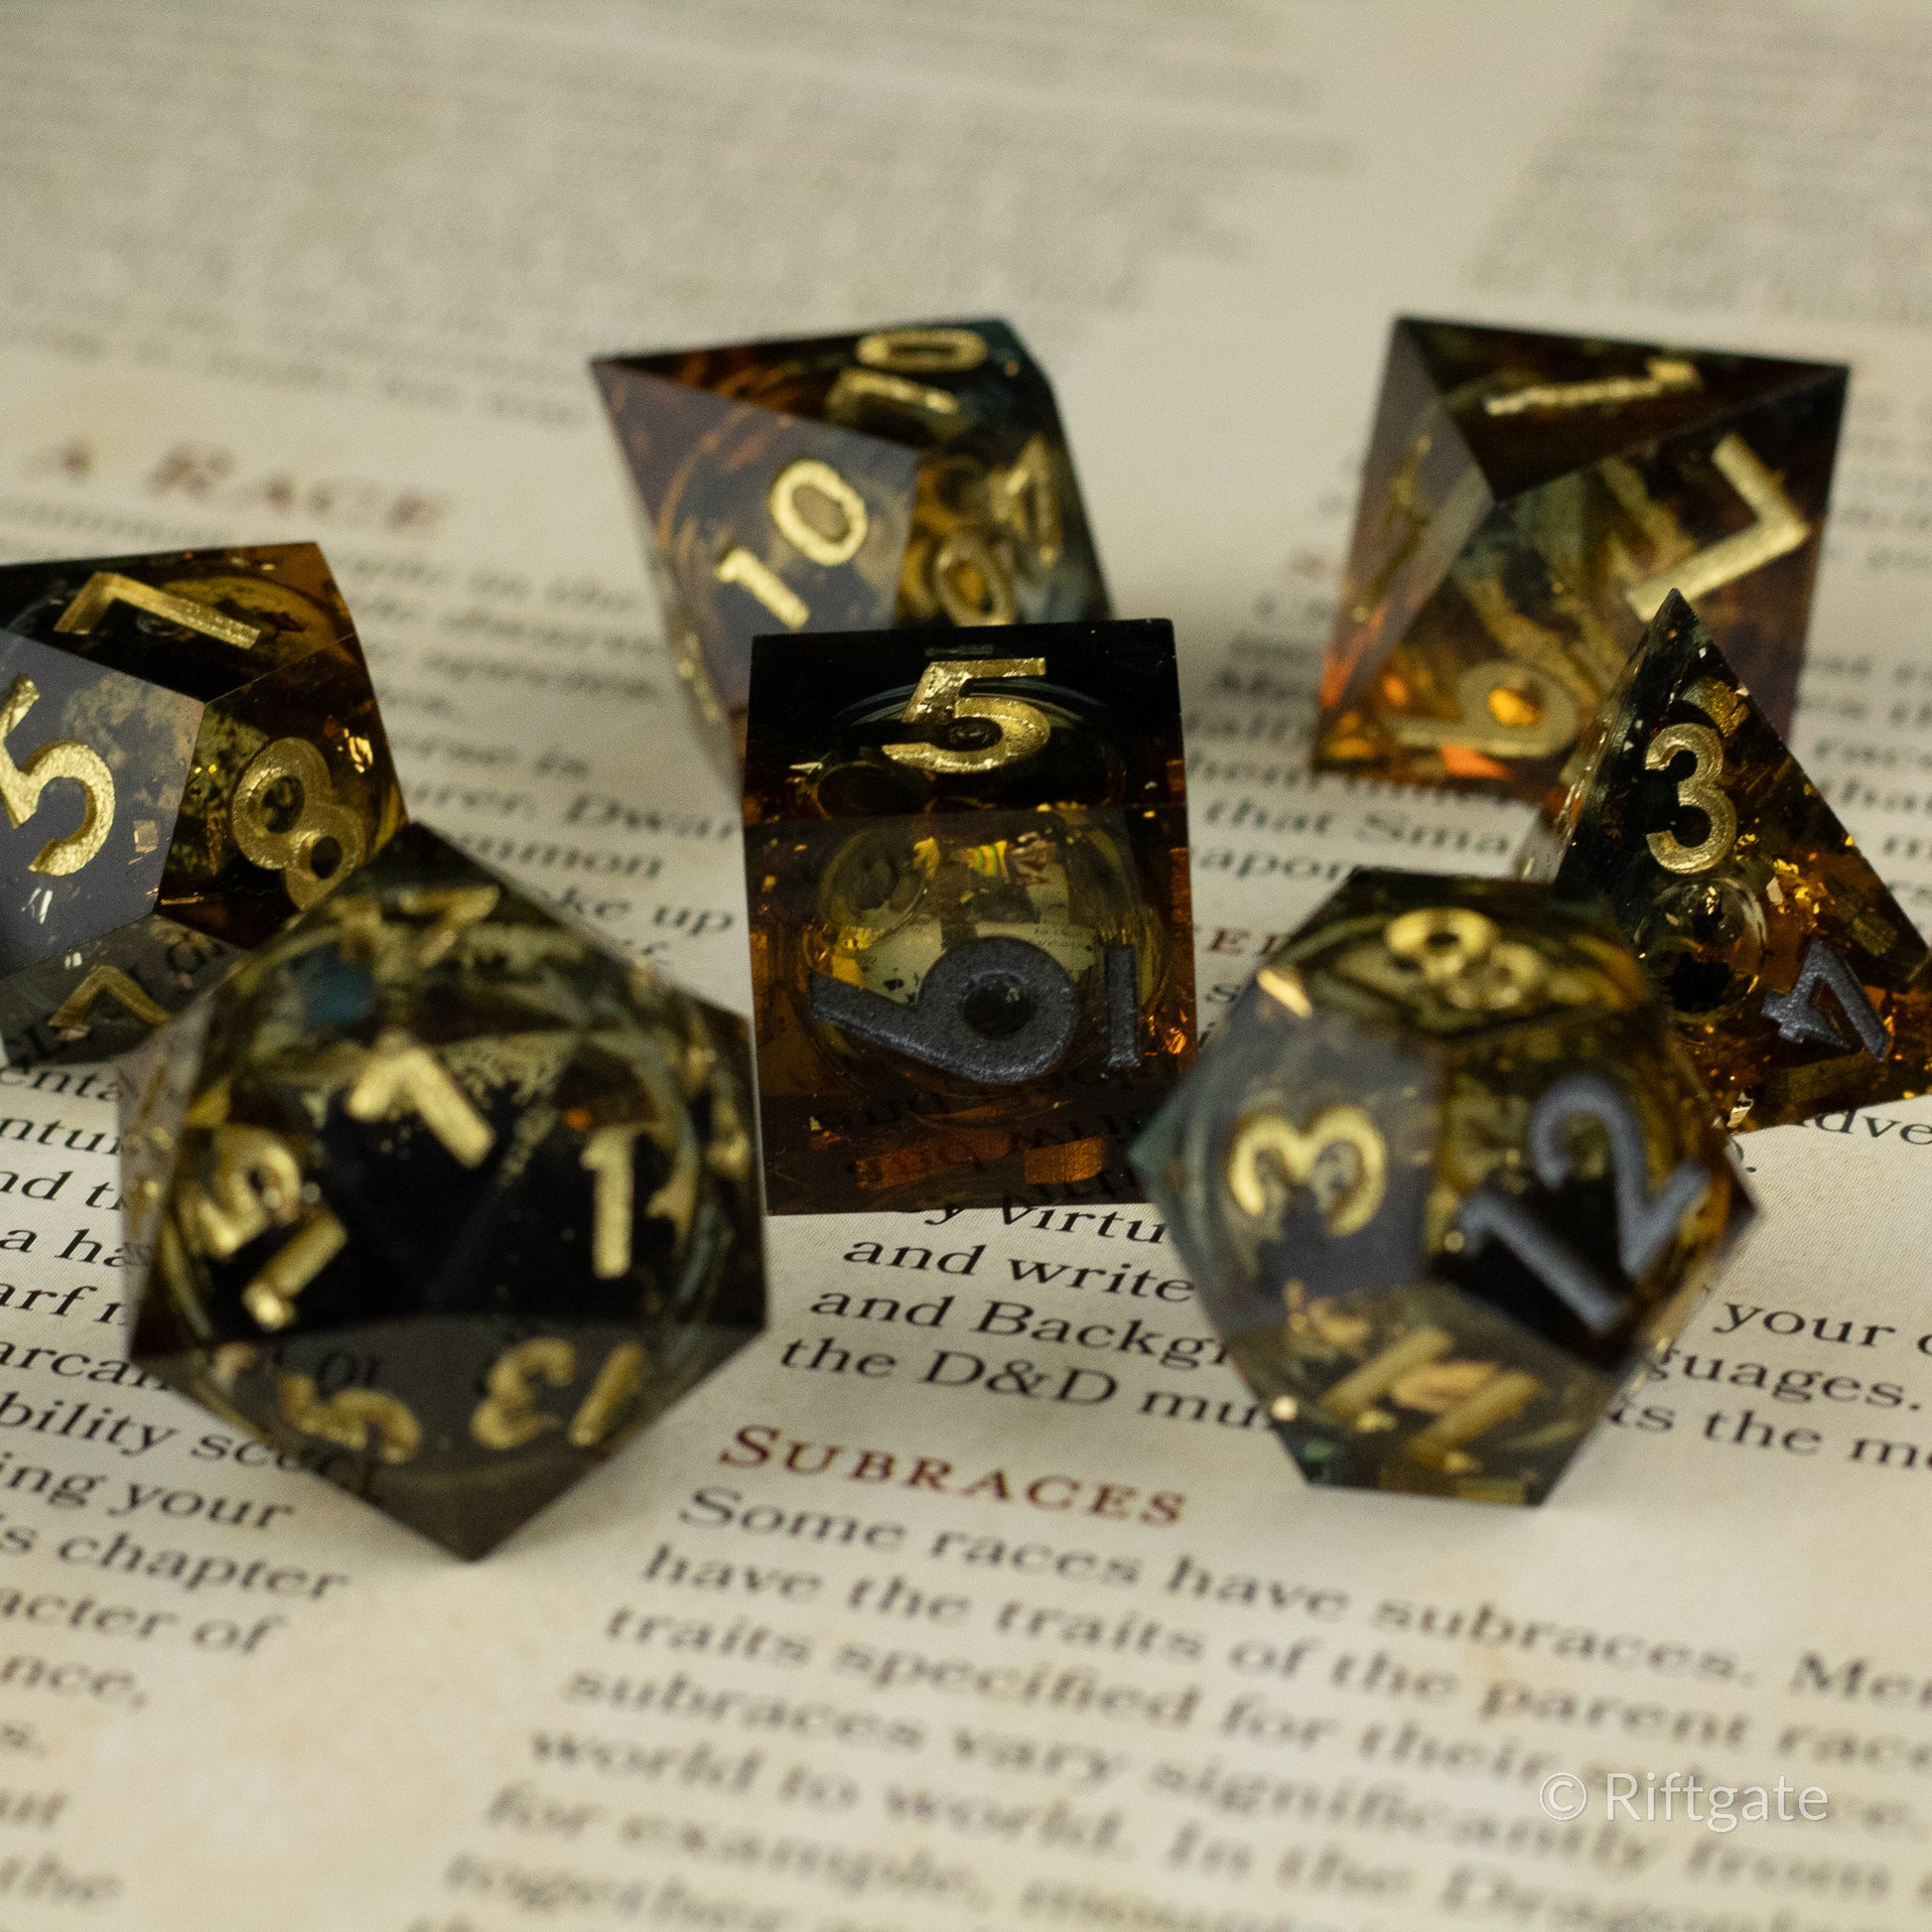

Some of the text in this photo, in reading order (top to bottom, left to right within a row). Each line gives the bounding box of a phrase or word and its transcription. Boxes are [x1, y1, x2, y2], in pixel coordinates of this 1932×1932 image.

[714, 459, 869, 629] 10
[880, 656, 1051, 774] 5
[0, 673, 115, 877] 5
[230, 737, 367, 910] 8
[1644, 723, 1737, 875] 3
[1227, 1102, 1388, 1239] 3
[1795, 1106, 1932, 1146] dve
[1459, 1076, 1714, 1335] 12
[809, 1292, 955, 1329] and
[843, 1241, 1194, 1303] and write
[1713, 1301, 1896, 1348] your
[780, 1336, 1267, 1430] the D&D mu
[1703, 1409, 1824, 1455] the
[107, 1482, 296, 1529] your
[719, 1424, 1187, 1528] SUBRACES
[58, 1531, 350, 1601] chapter
[678, 1486, 906, 1551] Some
[929, 1527, 1142, 1586] races
[1167, 1552, 1349, 1619] have
[191, 1613, 289, 1656] of
[641, 1542, 824, 1603] have
[846, 1576, 973, 1626] the
[995, 1598, 1207, 1663] traits
[1330, 1647, 1459, 1703] the
[1476, 1678, 1751, 1751] parent
[561, 1668, 927, 1754] subraces
[602, 1605, 1556, 1787] traits specified for their
